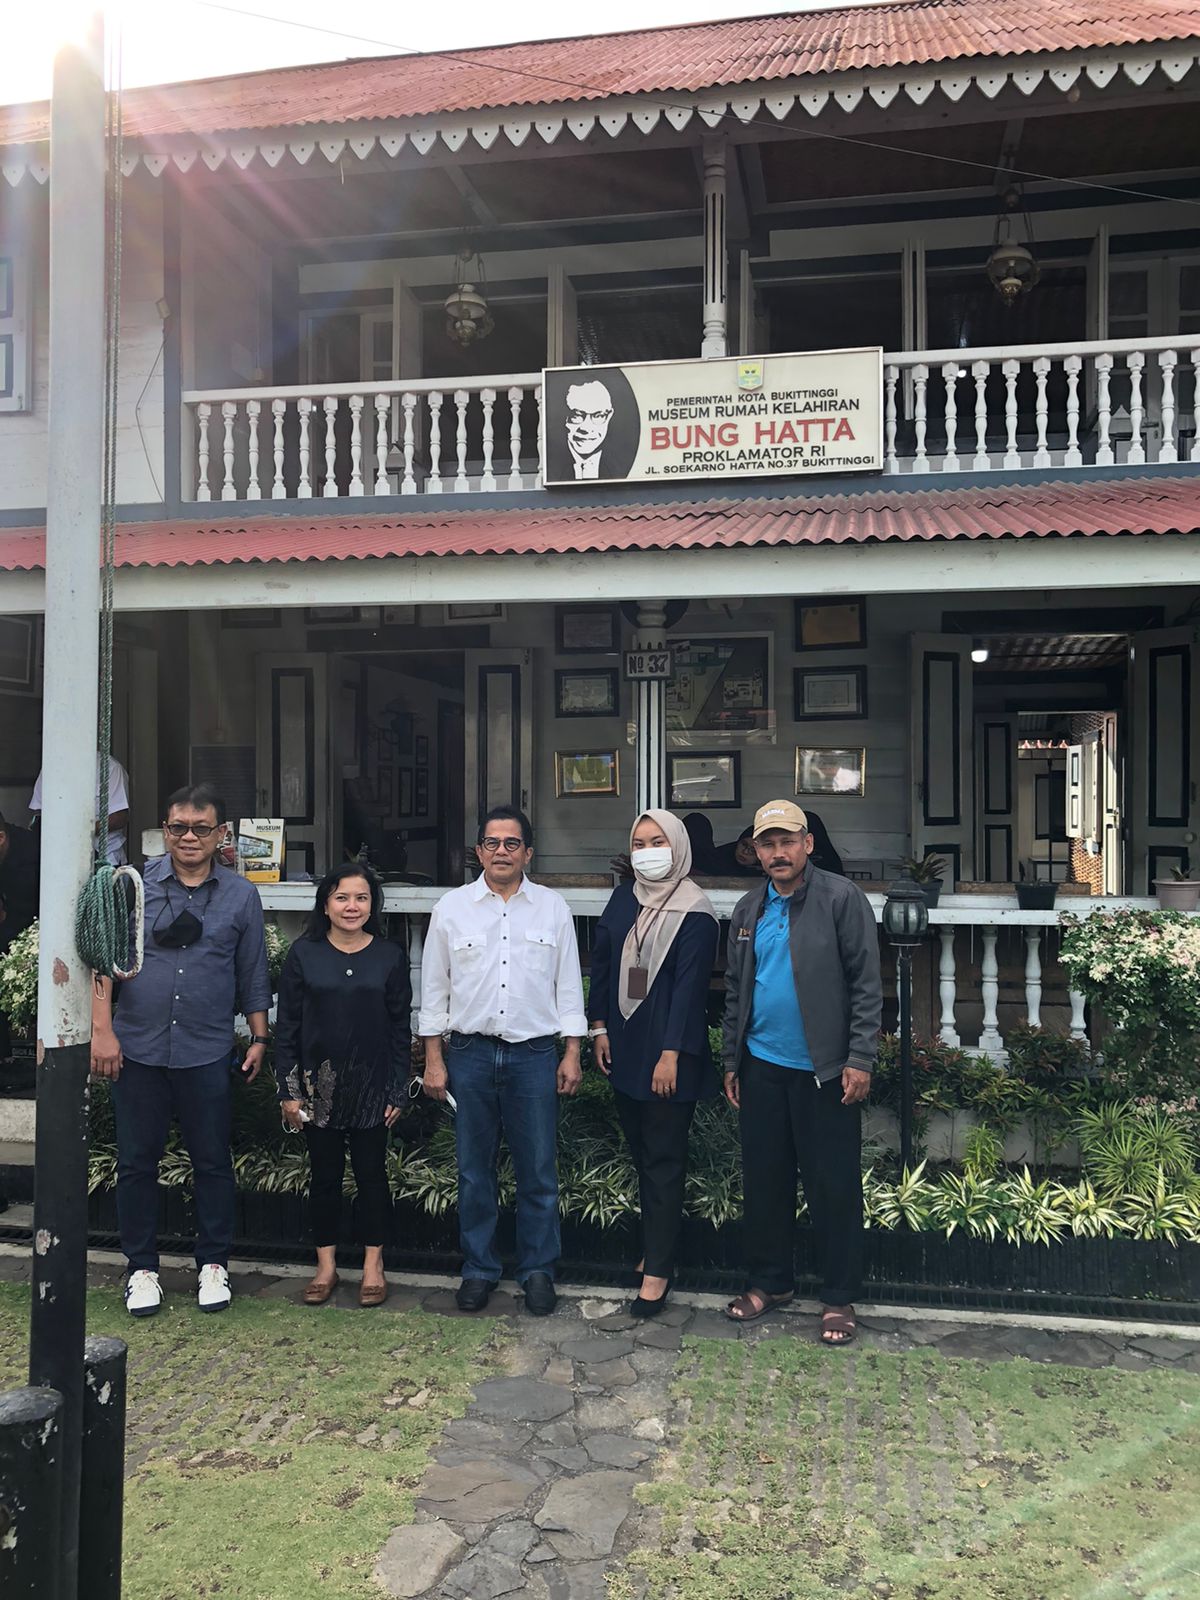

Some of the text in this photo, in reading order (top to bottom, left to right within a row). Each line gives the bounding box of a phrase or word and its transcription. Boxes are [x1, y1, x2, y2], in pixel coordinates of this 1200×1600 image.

[667, 389, 838, 406] PEMERINTAH KOTA BUKITTINGGI
[648, 398, 860, 421] MUSEUM RUMAH KELAHIRAN
[651, 417, 855, 450] BUNG HATTA
[682, 445, 825, 463] PROKLAMATOR RI
[645, 456, 875, 474] JL. SOEKARNO HATTA NO.37 BUKITTINGGI
[648, 654, 669, 673] 37
